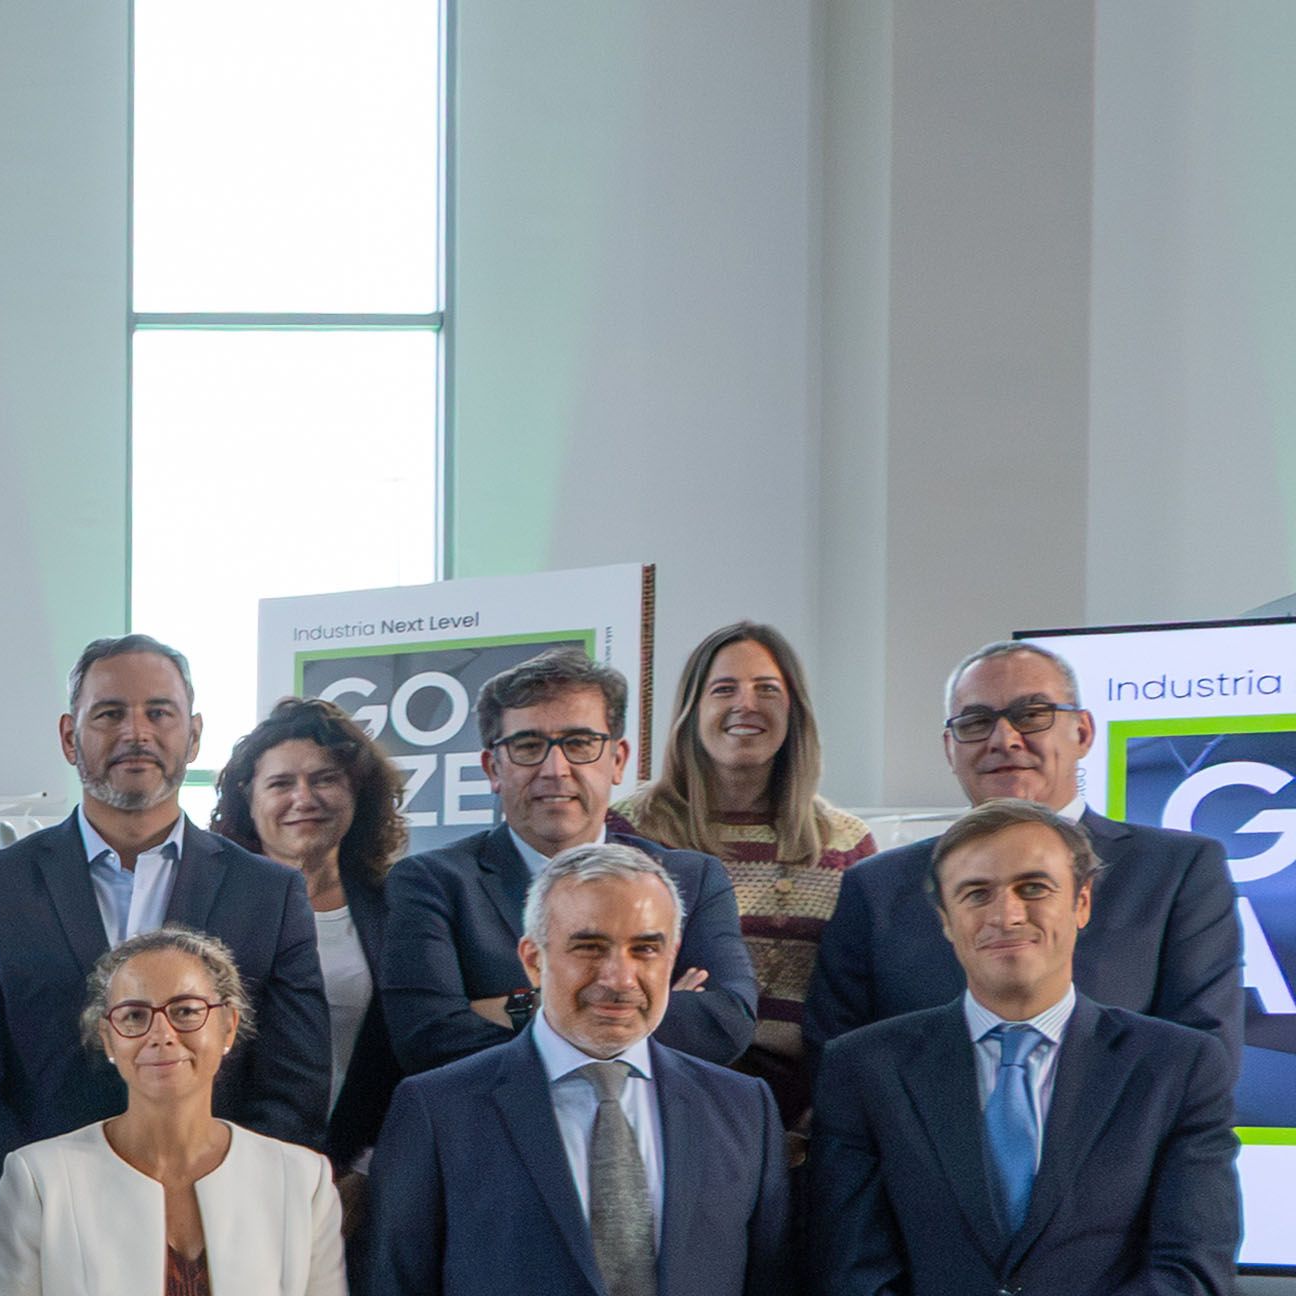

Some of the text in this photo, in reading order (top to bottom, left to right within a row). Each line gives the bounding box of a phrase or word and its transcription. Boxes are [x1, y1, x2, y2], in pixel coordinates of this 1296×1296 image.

[294, 611, 480, 641] Industria Next Level
[320, 671, 469, 746] GO
[1108, 669, 1282, 701] Industria
[387, 752, 496, 827] ZE
